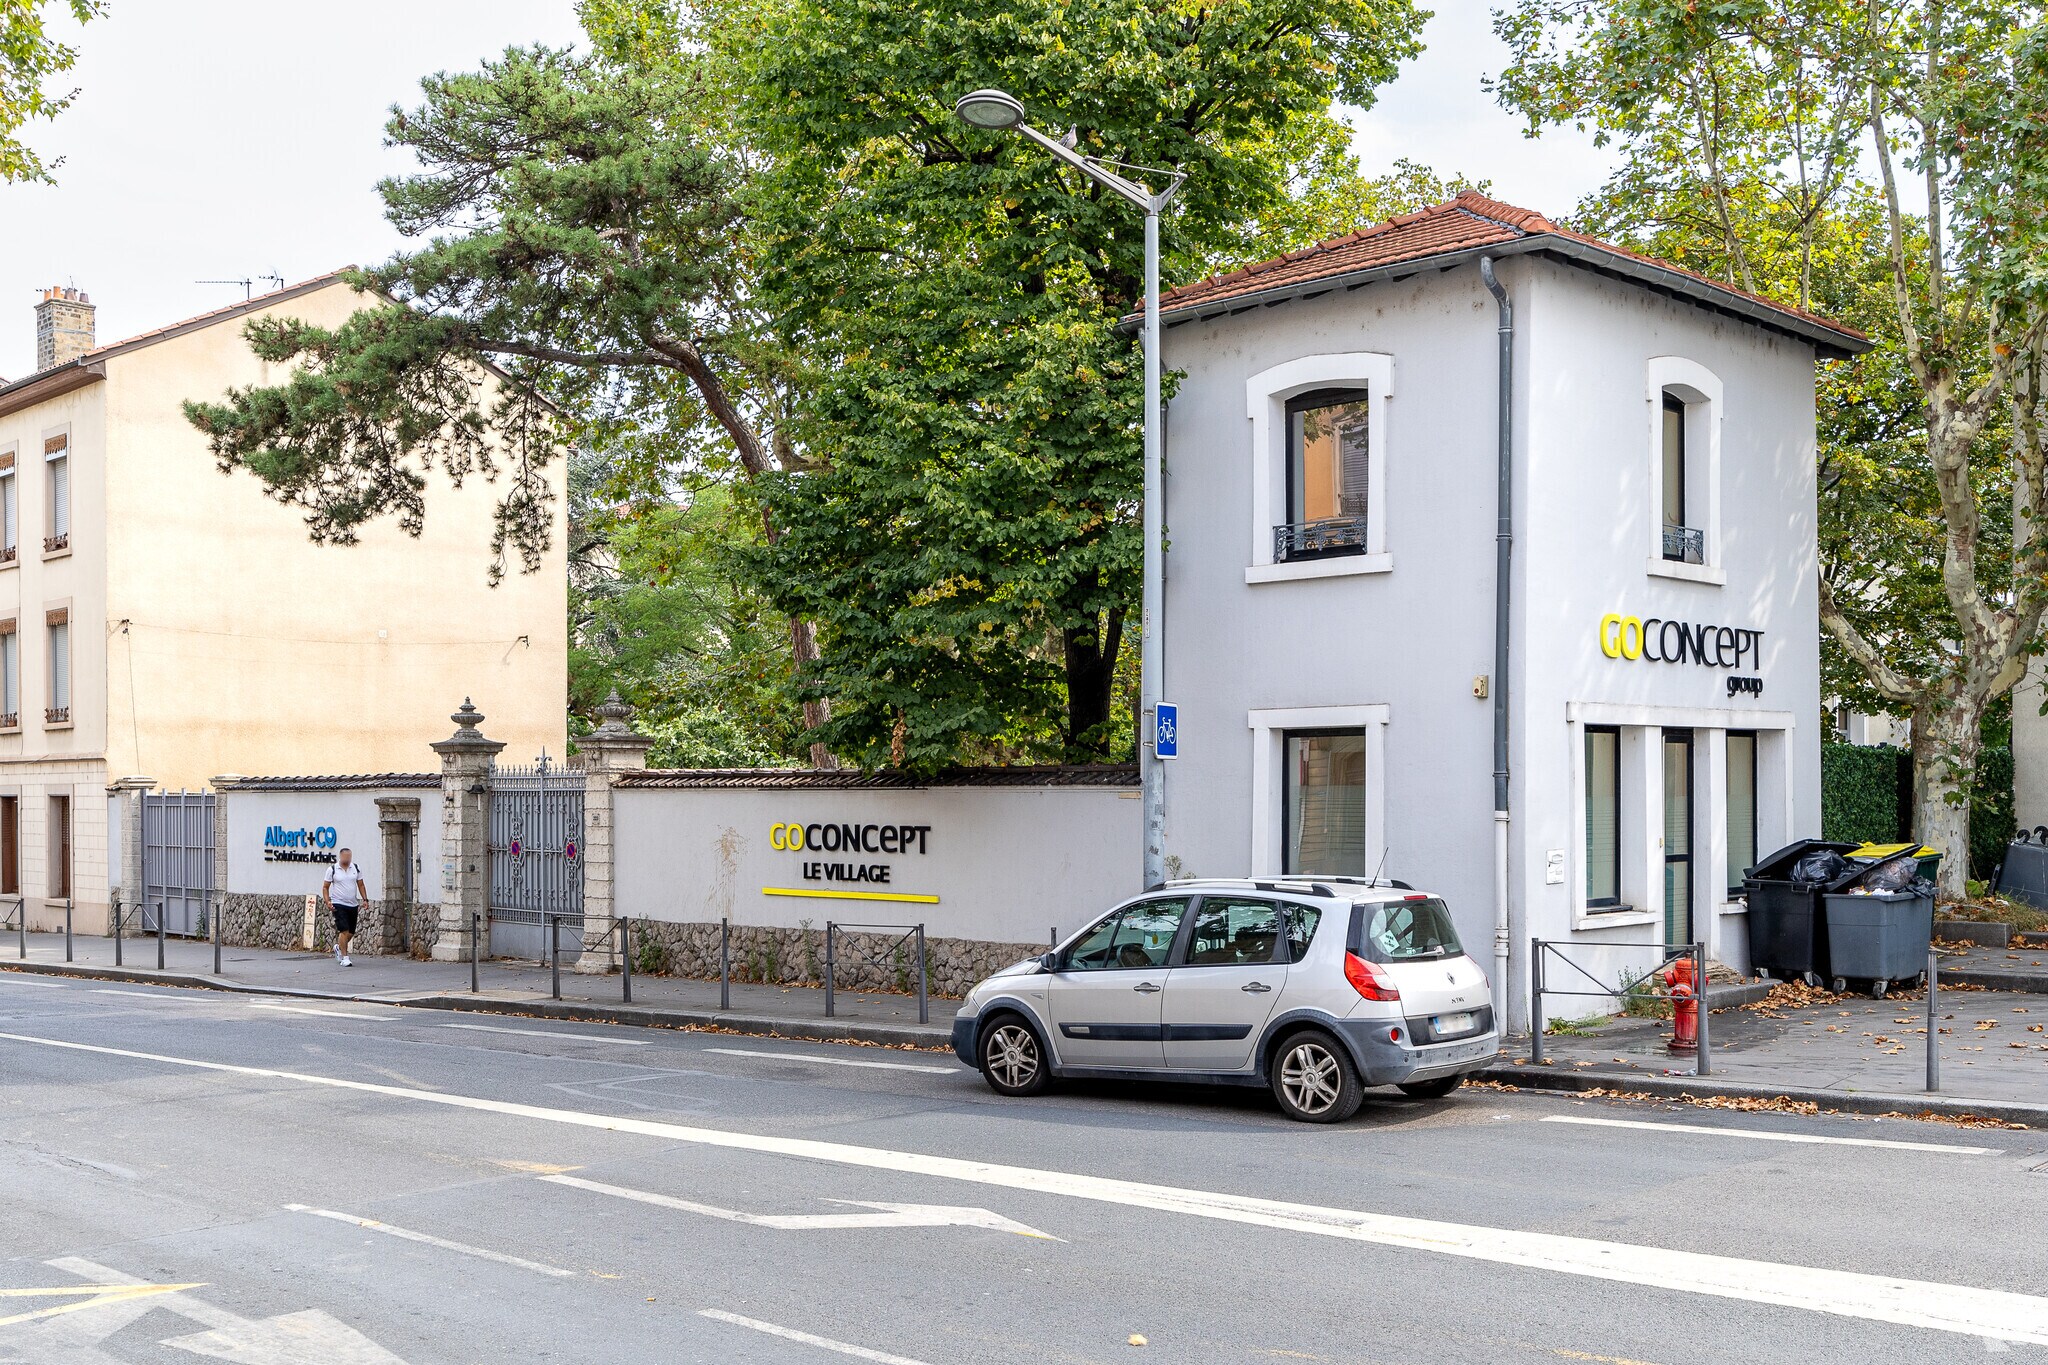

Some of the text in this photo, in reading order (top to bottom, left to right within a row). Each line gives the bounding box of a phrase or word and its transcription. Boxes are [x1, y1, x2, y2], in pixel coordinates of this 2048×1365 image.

[1726, 675, 1763, 699] group
[273, 850, 309, 863] Solutions
[310, 851, 337, 863] Achats
[803, 862, 890, 883] LE VILLAGE
